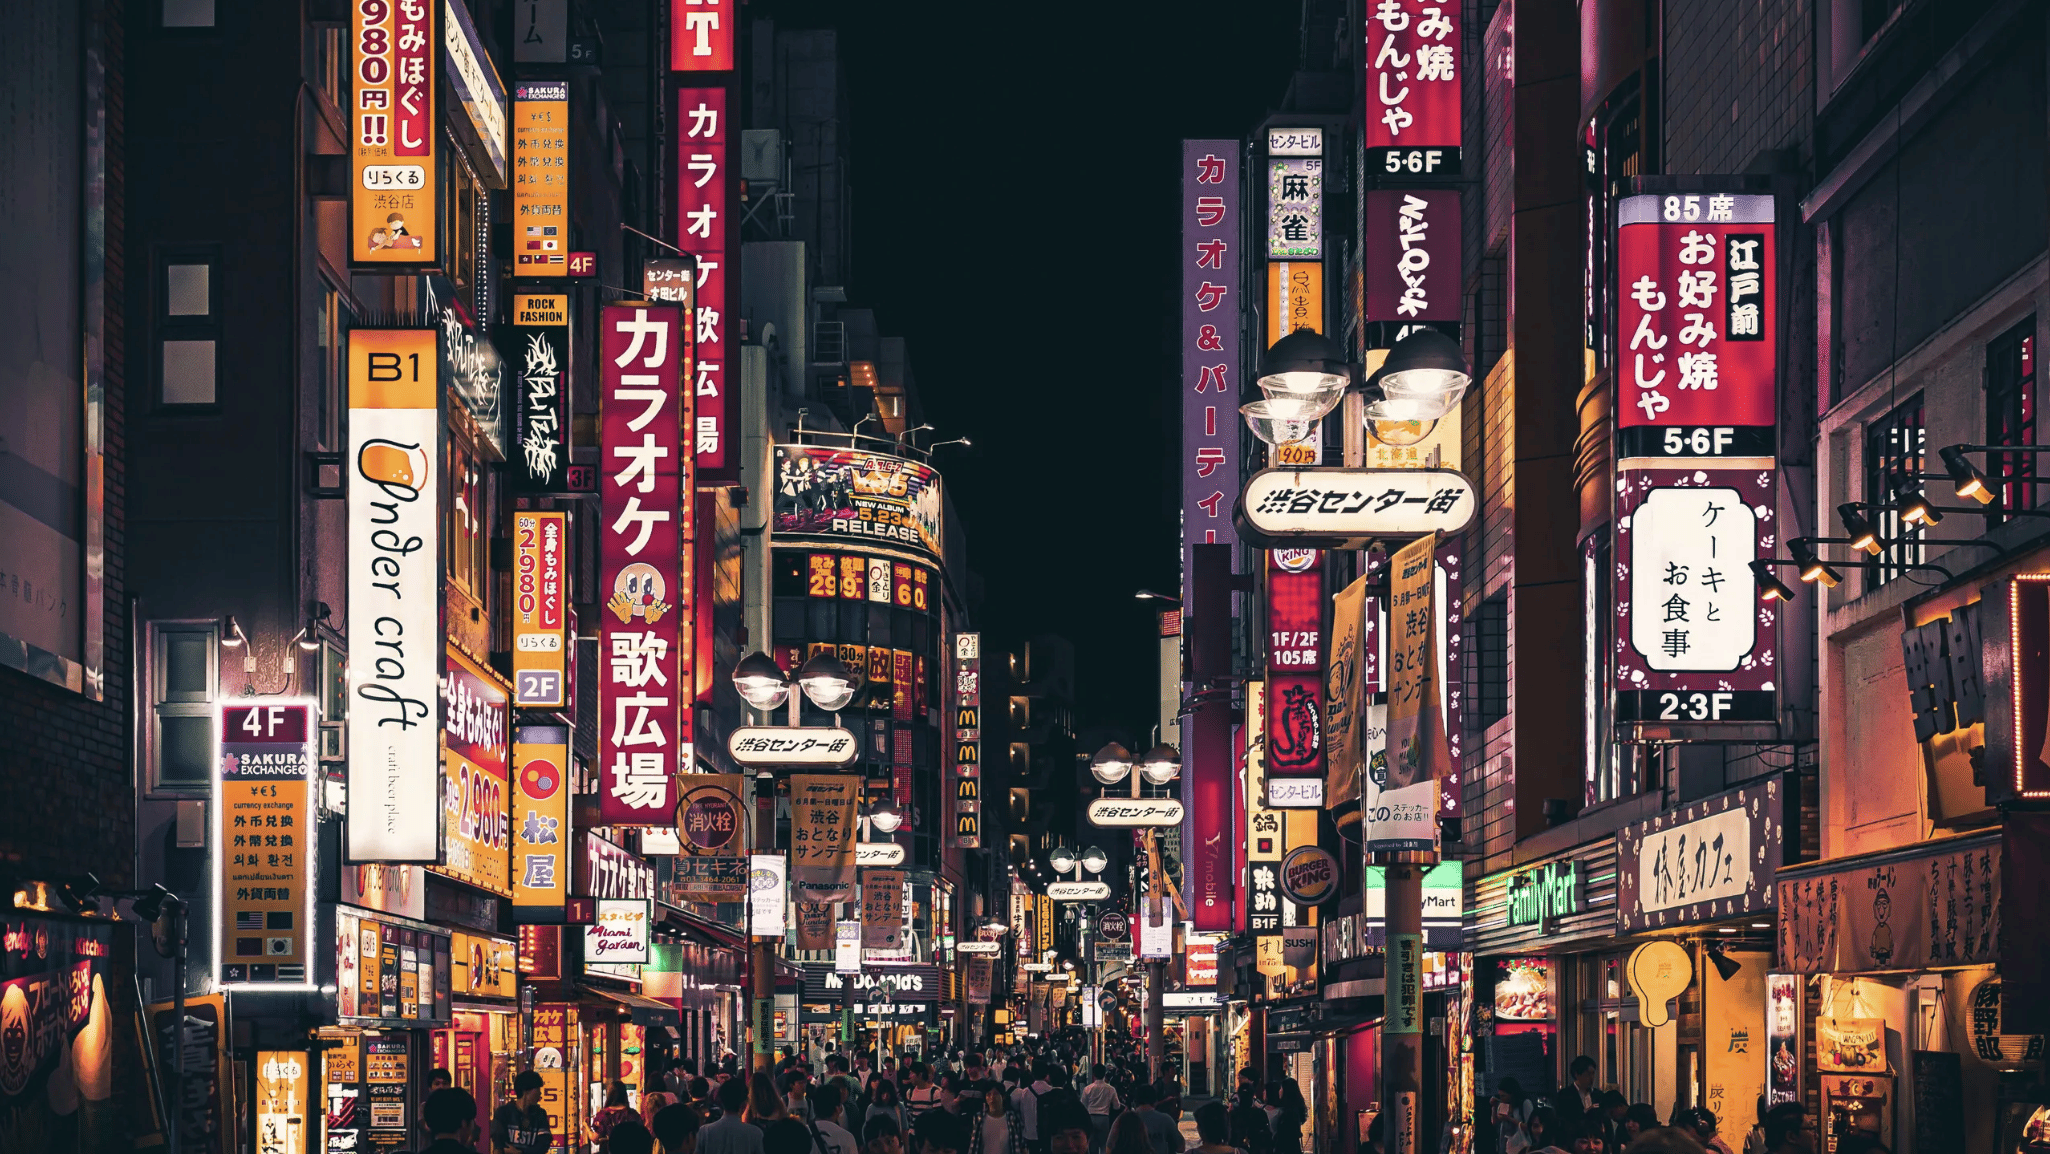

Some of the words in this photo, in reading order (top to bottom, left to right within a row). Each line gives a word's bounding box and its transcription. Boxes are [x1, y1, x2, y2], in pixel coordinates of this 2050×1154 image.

[1416, 0, 1455, 82] み焼
[399, 0, 426, 149] もみほぐし
[528, 86, 566, 94] SAKURA
[1269, 134, 1321, 150] センタービル
[1305, 160, 1321, 171] 5F
[368, 170, 419, 185] りらくる
[374, 194, 415, 209] 渋谷店
[520, 204, 562, 215] 外貨両替
[1281, 174, 1309, 241] 麻雀
[1663, 193, 1734, 222] 85席
[570, 257, 592, 273] 4F
[1730, 239, 1760, 336] 江戸前
[527, 298, 556, 310] ROCK
[1677, 230, 1718, 391] お好み焼
[519, 310, 563, 323] FASHION
[368, 352, 419, 382] B1
[611, 308, 670, 557] カラオケ
[571, 469, 592, 488] 3F
[855, 500, 877, 508] NEW
[876, 502, 905, 514] ALBUM
[1256, 488, 1465, 515] 渋谷センター街
[832, 517, 920, 544] RELEASE
[1282, 549, 1310, 562] KING
[1701, 501, 1726, 623] ケーキと
[543, 522, 558, 625] 全身もみほぐし
[1661, 560, 1691, 659] お食事
[520, 637, 558, 648] りらくる
[1271, 631, 1319, 647] 1F/2F
[1273, 649, 1318, 666] 105席
[524, 676, 555, 698] 2F
[242, 706, 286, 737] 4F
[610, 630, 669, 810] 歌広場
[735, 738, 850, 753] 渋谷センター街
[240, 753, 308, 765] SAKURA
[240, 764, 298, 775] EXCHANGE
[1269, 784, 1322, 800] センタービル
[233, 802, 261, 811] currency
[262, 801, 294, 811] exchange
[1094, 806, 1180, 818] 渋谷センター街
[1393, 803, 1429, 813] ステッカー
[689, 811, 732, 832] 消火栓
[810, 809, 840, 825] 渋谷
[1252, 813, 1279, 833] 鍋
[796, 827, 852, 842] おとなり
[520, 811, 559, 889] 松屋
[796, 844, 853, 859] サンデー
[233, 853, 260, 867] 외화
[267, 853, 294, 867] 환전
[1652, 831, 1734, 904] 椿屋カフェ
[1288, 858, 1329, 879] BURGER
[799, 880, 850, 890] Panasonic
[1290, 867, 1331, 892] KING
[236, 887, 290, 901] 外貨両替
[873, 891, 892, 901] 渋谷
[1506, 859, 1578, 935] FamilyMart
[864, 903, 900, 911] おとなり
[864, 914, 900, 922] サンデー
[1252, 917, 1278, 930] B1F
[587, 925, 633, 938] Miami
[595, 939, 645, 956] garden
[1284, 938, 1316, 949] SUSHI
